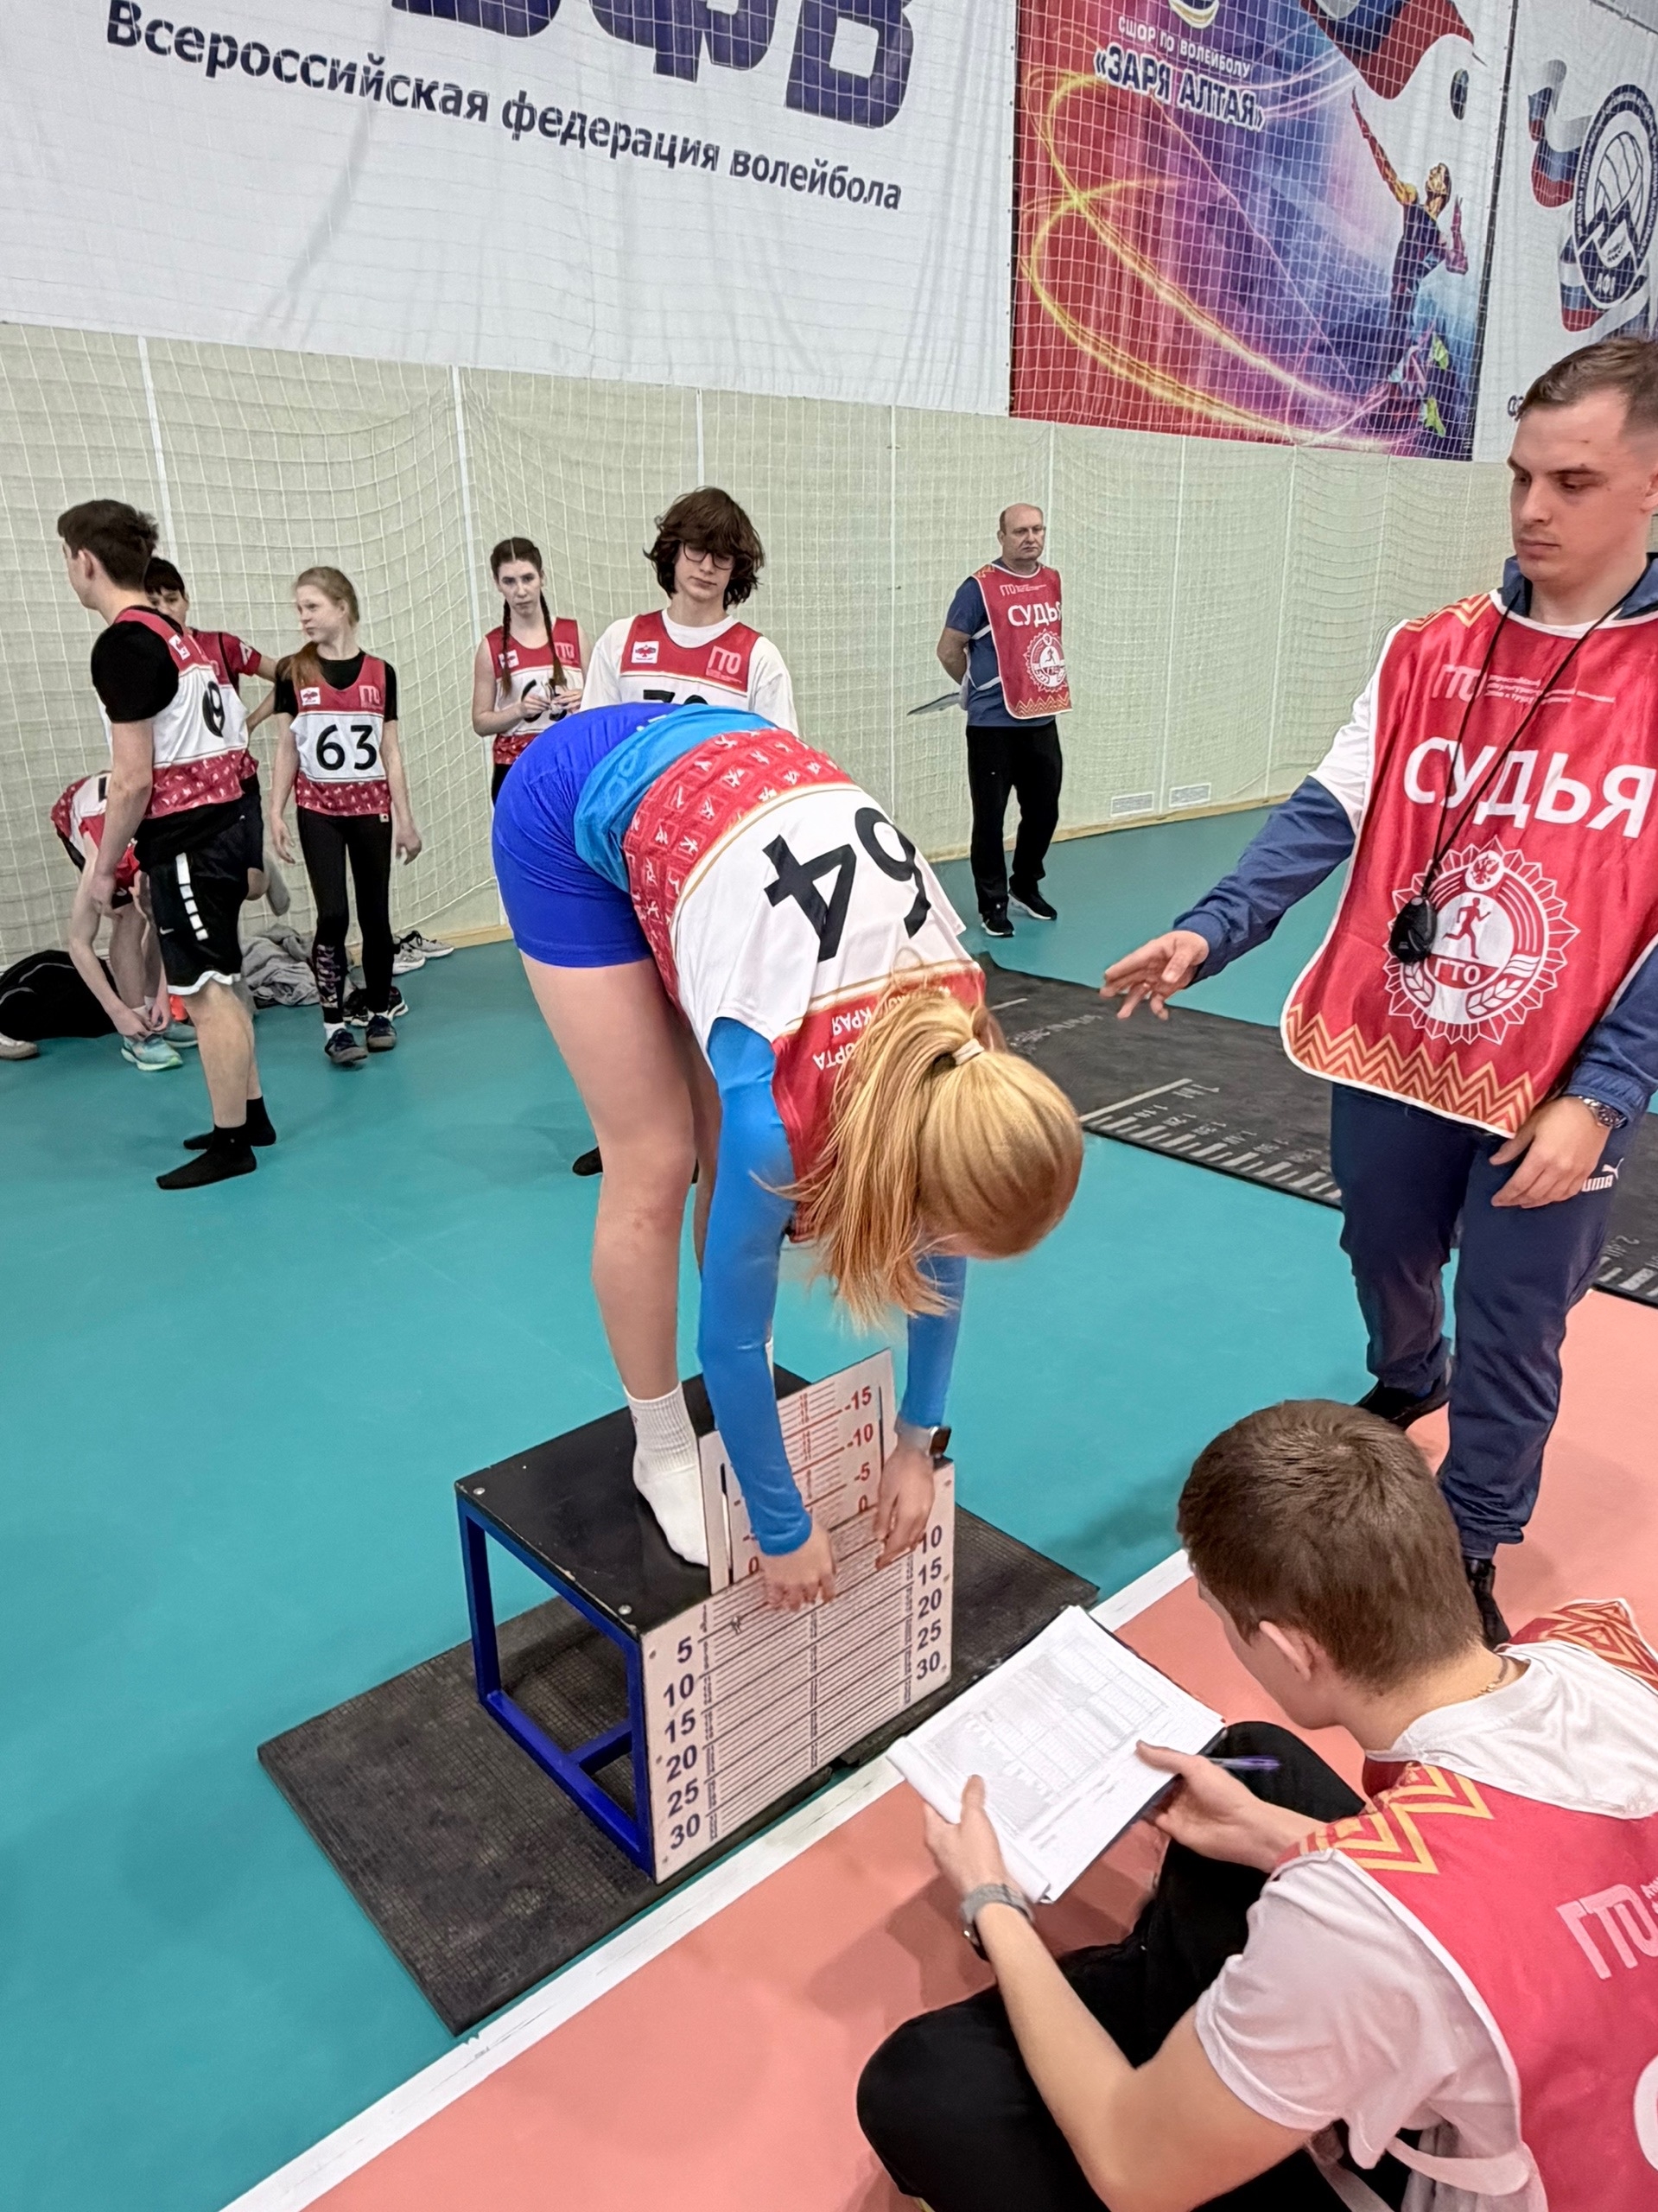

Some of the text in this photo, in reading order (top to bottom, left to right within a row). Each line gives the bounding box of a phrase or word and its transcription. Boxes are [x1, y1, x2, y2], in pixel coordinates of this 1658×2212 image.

[1118, 16, 1251, 79] СШОР ПО ВОЛЕЙБОЛУ
[1094, 44, 1266, 130] «ЗАРЯ АЛТАЯ»
[106, 0, 490, 123] Всероссийская
[500, 90, 720, 171] федерация
[729, 149, 901, 210] волейбола
[316, 724, 377, 771] 63
[1403, 736, 1657, 839] СУДЬЯ
[1435, 957, 1481, 985] ГТО
[831, 1006, 873, 1036] КРАЯ
[812, 1042, 856, 1071] ОРТА
[1581, 1174, 1613, 1193] UMA
[844, 1385, 873, 1410] -15
[847, 1422, 873, 1447] -10
[854, 1461, 870, 1482] -5
[858, 1494, 868, 1512] 0
[920, 1524, 943, 1554] 10
[748, 1555, 759, 1574] 0
[918, 1556, 942, 1586] 15
[918, 1587, 943, 1620] 20
[677, 1636, 693, 1663] 5
[917, 1618, 942, 1651] 25
[916, 1650, 941, 1681] 30
[663, 1673, 695, 1708] 10
[664, 1708, 696, 1744] 15
[666, 1744, 698, 1783] 20
[667, 1778, 699, 1816] 25
[670, 1813, 701, 1850] 30
